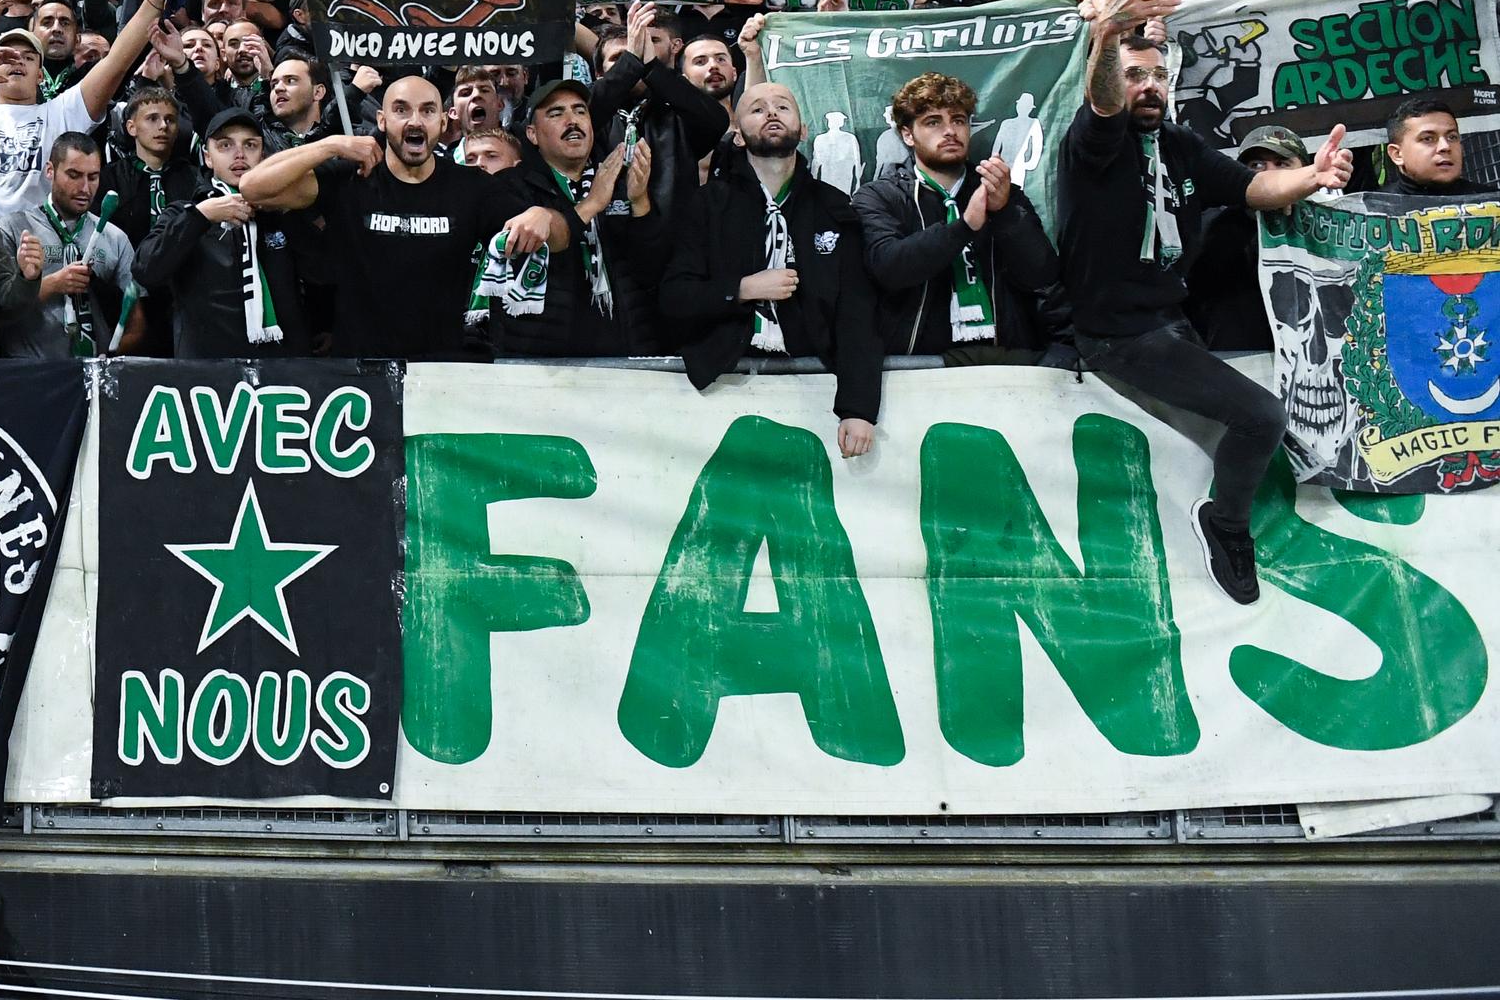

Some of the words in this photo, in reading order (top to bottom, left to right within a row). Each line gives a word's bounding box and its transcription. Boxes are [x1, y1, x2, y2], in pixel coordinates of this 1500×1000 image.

[388, 31, 457, 59] AVEC
[464, 30, 536, 58] NOUS
[866, 13, 1084, 58] Gardons
[1272, 39, 1491, 112] ARDECHE
[410, 217, 450, 234] NORD
[126, 383, 376, 480] AVEC
[1391, 427, 1469, 461] MAGIC
[118, 667, 372, 767] NOUS
